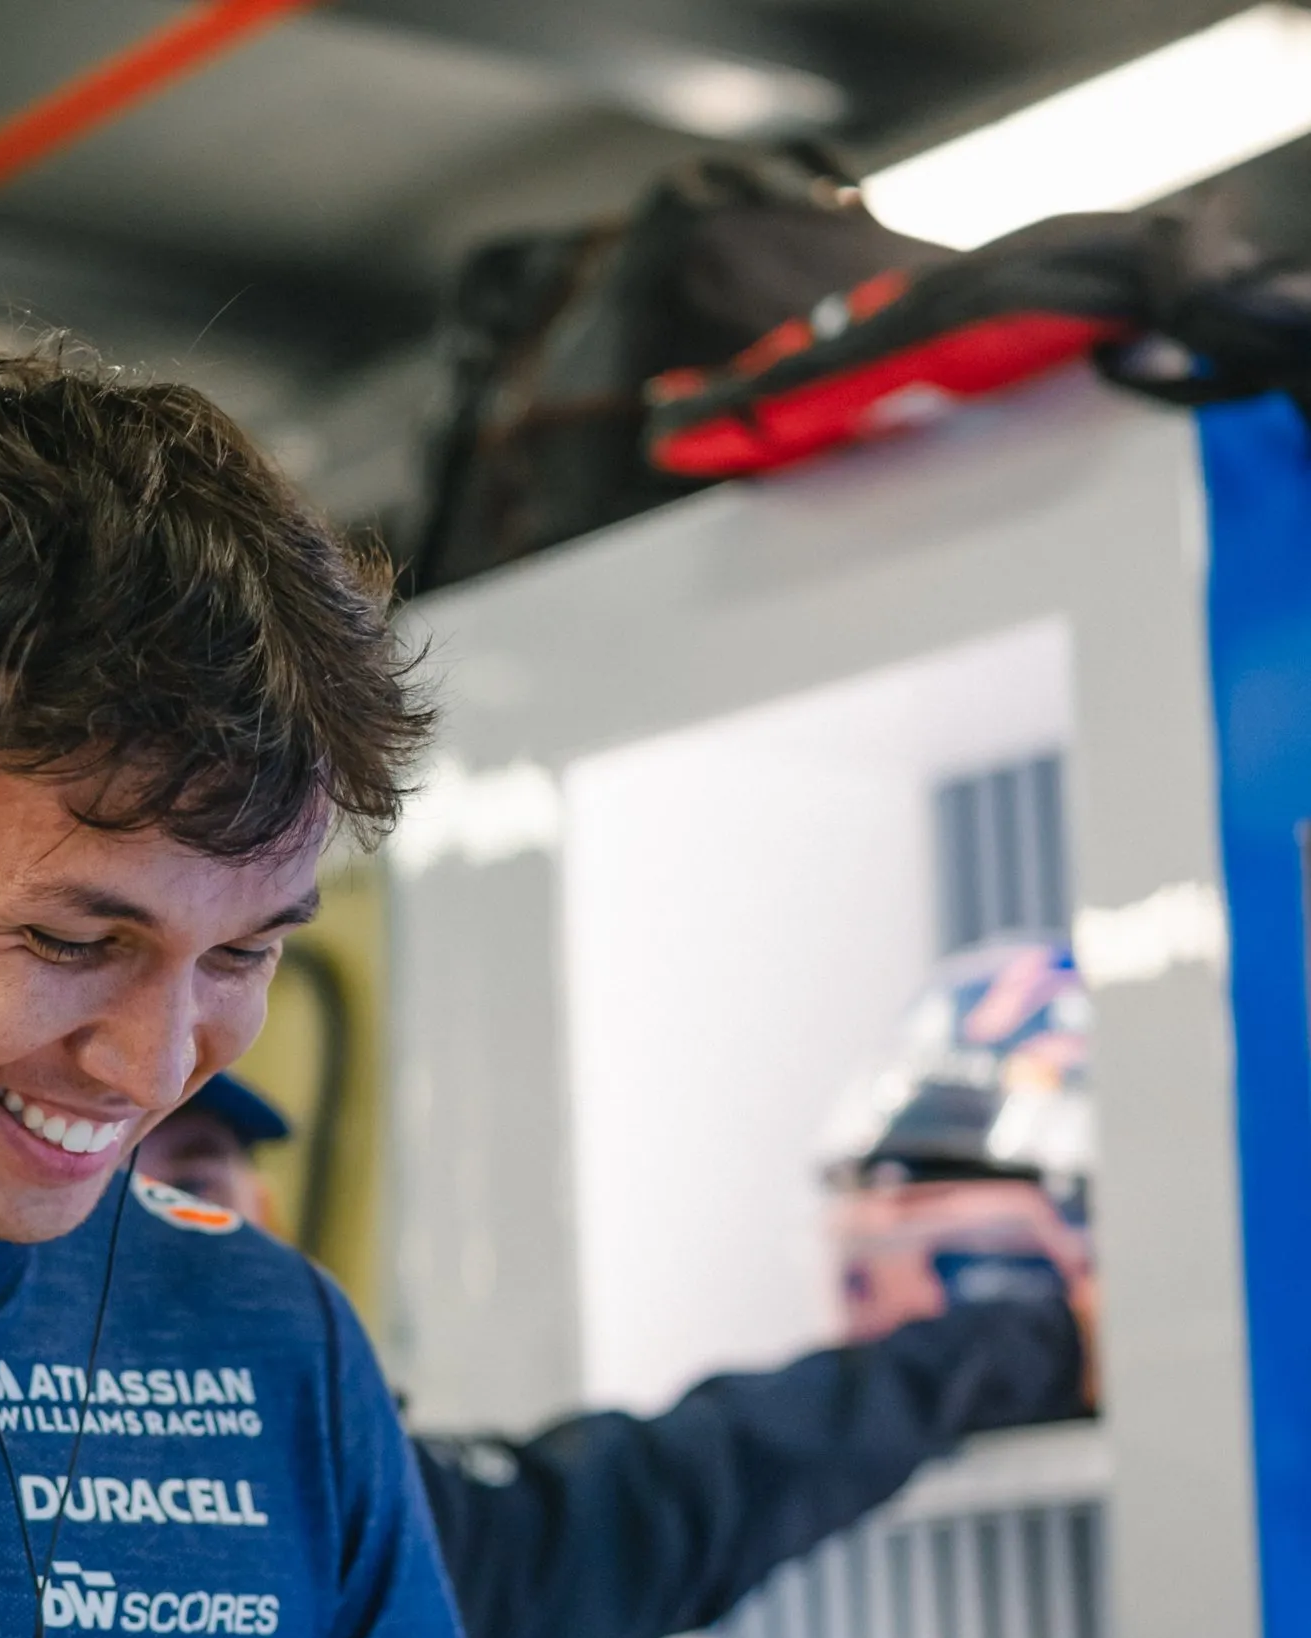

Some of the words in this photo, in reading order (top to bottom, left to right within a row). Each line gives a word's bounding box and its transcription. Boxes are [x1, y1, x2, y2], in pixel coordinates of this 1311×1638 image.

[29, 1363, 257, 1406] ATLASSIAN
[144, 1409, 263, 1437] RACING
[19, 1475, 269, 1526] DURACELL
[119, 1591, 280, 1635] SCORES
